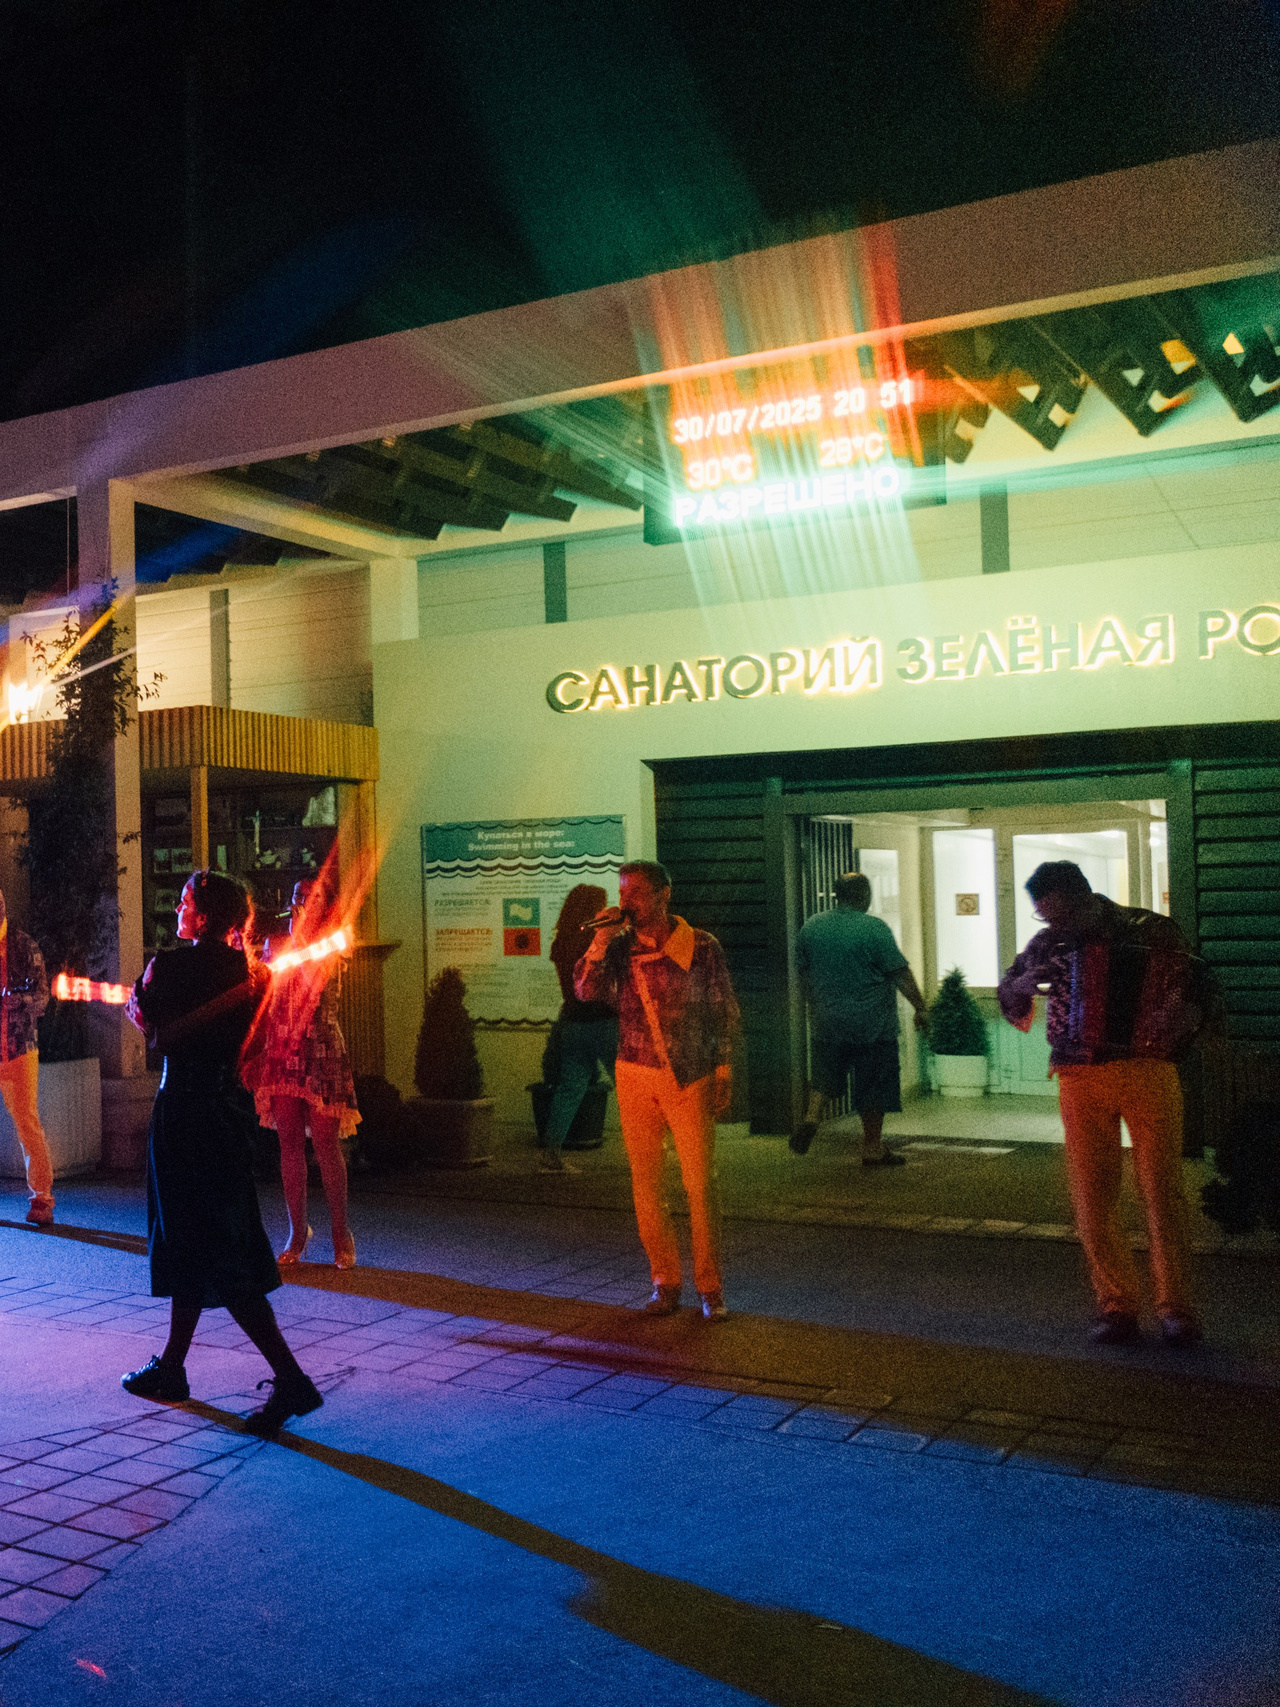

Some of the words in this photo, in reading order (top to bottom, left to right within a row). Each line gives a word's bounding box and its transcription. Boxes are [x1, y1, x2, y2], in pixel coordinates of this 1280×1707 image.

[674, 394, 822, 444] 30/07/2025
[686, 453, 754, 491] 30°C
[675, 465, 900, 528] РАЗРЕШЕНО
[545, 635, 884, 714] САНАТОРИЙ
[896, 614, 1175, 684] ЗЕЛЁНАЯ
[468, 842, 519, 852] Swimming
[522, 840, 532, 849] in
[534, 840, 551, 849] the
[477, 831, 523, 842] Купаться
